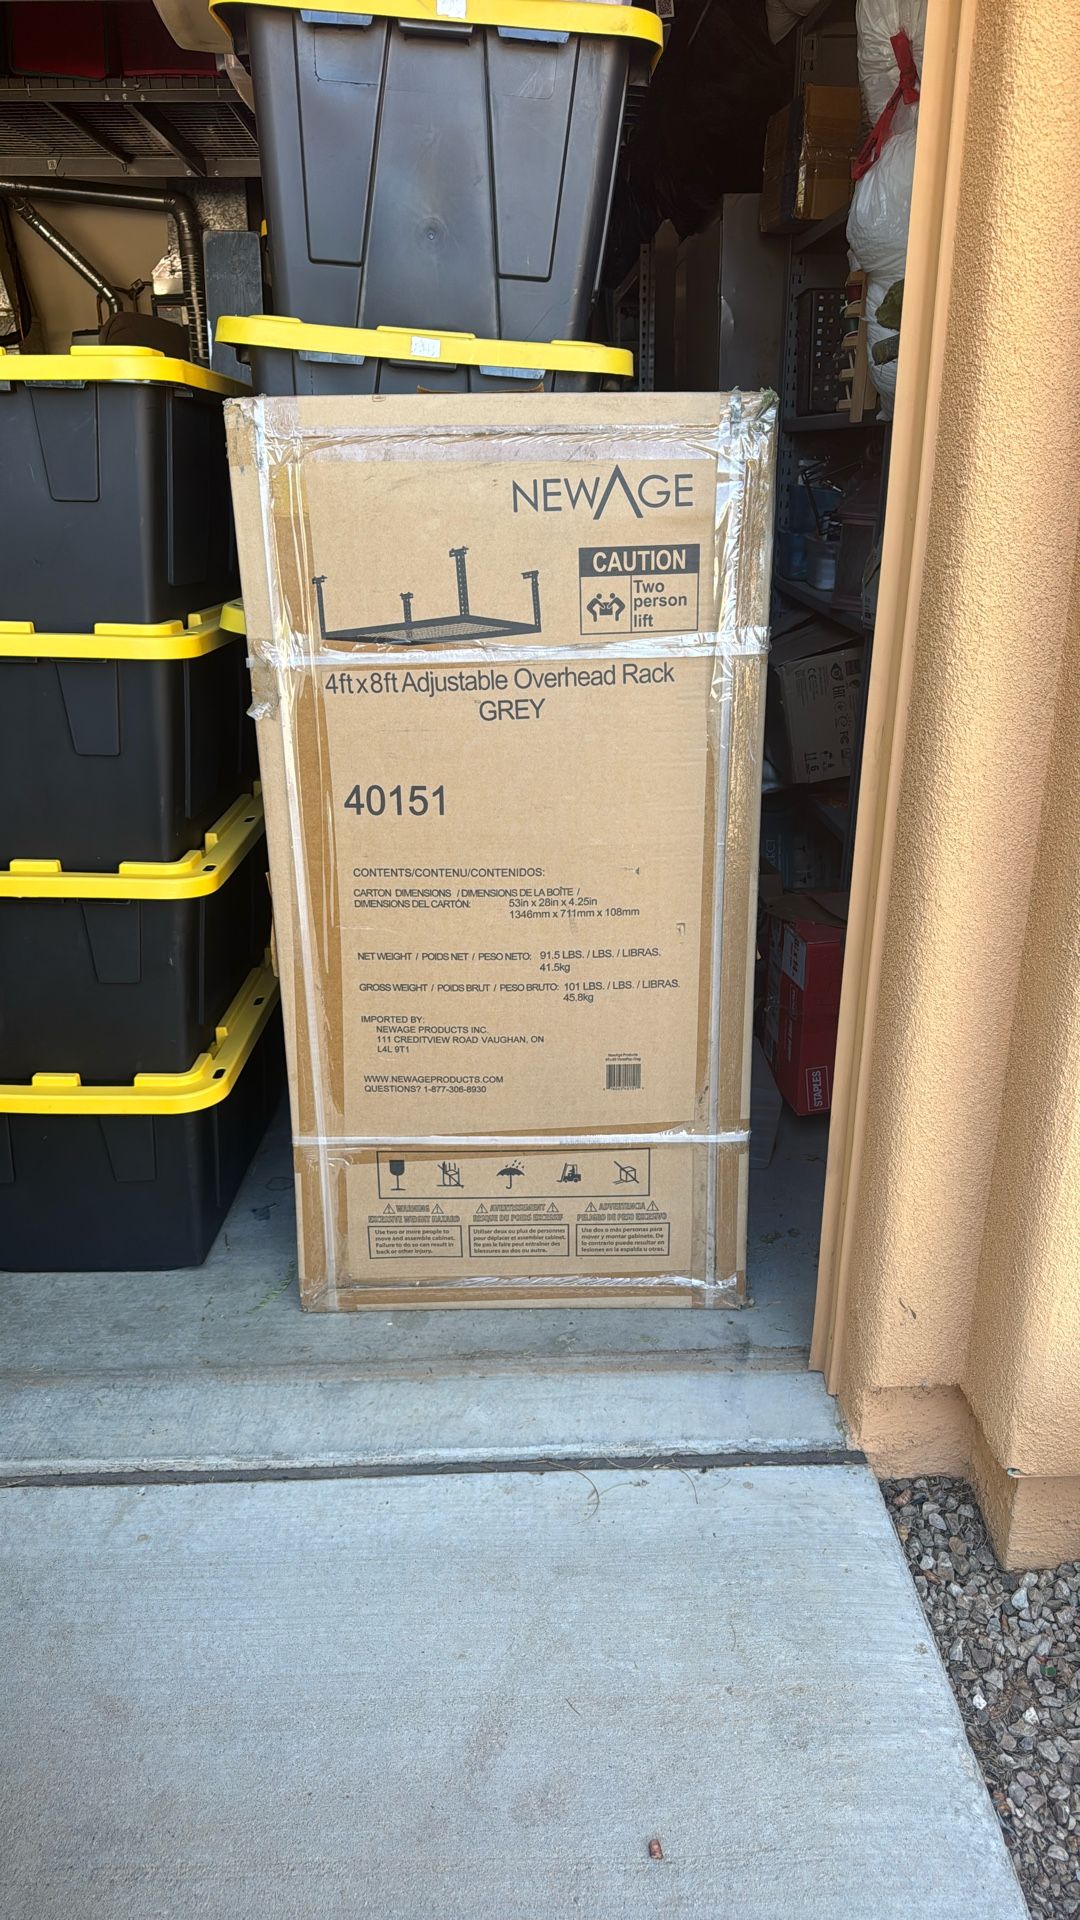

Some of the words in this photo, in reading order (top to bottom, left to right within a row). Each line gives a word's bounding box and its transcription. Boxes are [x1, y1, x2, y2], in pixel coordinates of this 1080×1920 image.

[512, 464, 693, 520] NEWAGE
[592, 549, 686, 573] CAUTION
[633, 579, 665, 593] Two
[633, 595, 687, 611] person
[633, 614, 654, 628] lift
[402, 669, 508, 697] Adjustable
[514, 664, 616, 690] Overhead
[622, 661, 675, 685] Rack
[479, 698, 546, 721] GREY
[343, 784, 445, 817] 40151
[353, 867, 545, 878] CONTENTS/CONTENU/CONTENIDOS:
[353, 888, 392, 898] CARTON
[395, 888, 452, 898] DIMENSIONS
[462, 888, 518, 898] DIMENSIONS
[520, 888, 532, 898] DE
[534, 888, 546, 897] LA
[354, 900, 410, 908] DIMENSIONS
[412, 900, 430, 908] DEL
[508, 898, 528, 907] 53in
[538, 898, 559, 907] 28in
[568, 897, 598, 906] 4.25in
[510, 910, 550, 919] 1346mm
[560, 909, 595, 918] 711mm
[604, 908, 640, 917] 108mm
[358, 952, 375, 961] NET
[376, 952, 412, 961] WEIGHT
[421, 952, 450, 961] POIDS
[450, 952, 468, 961] NET
[478, 952, 503, 961] PESO
[504, 952, 532, 961] NETO:
[540, 951, 560, 959] 91.5
[562, 950, 585, 959] LBS.
[592, 950, 614, 958] LBS.
[622, 948, 662, 957] LIBRAS.
[540, 963, 571, 973] 41.5kg
[359, 984, 392, 992] GROSS
[392, 983, 428, 992] WEIGHT
[437, 983, 465, 992] POIDS
[466, 983, 490, 992] BRUT
[500, 983, 525, 992] PESO
[526, 983, 560, 991] BRUTO:
[564, 983, 580, 991] 101
[582, 982, 606, 990] LBS.
[612, 982, 635, 990] LBS.
[642, 980, 681, 989] LIBRAS.
[562, 994, 594, 1003] 45.8kg
[360, 1016, 408, 1024] IMPORTED
[410, 1016, 425, 1024] BY:
[376, 1026, 416, 1034] NEWAGE
[418, 1026, 469, 1034] PRODUCTS
[470, 1026, 489, 1034] INC.
[364, 1076, 504, 1084] WWW.NEWAGEPRODUCTS.COM
[364, 1086, 421, 1094] QUESTIONS?
[424, 1086, 487, 1094] 1-877-306-8930
[812, 1070, 824, 1108] STAPLES
